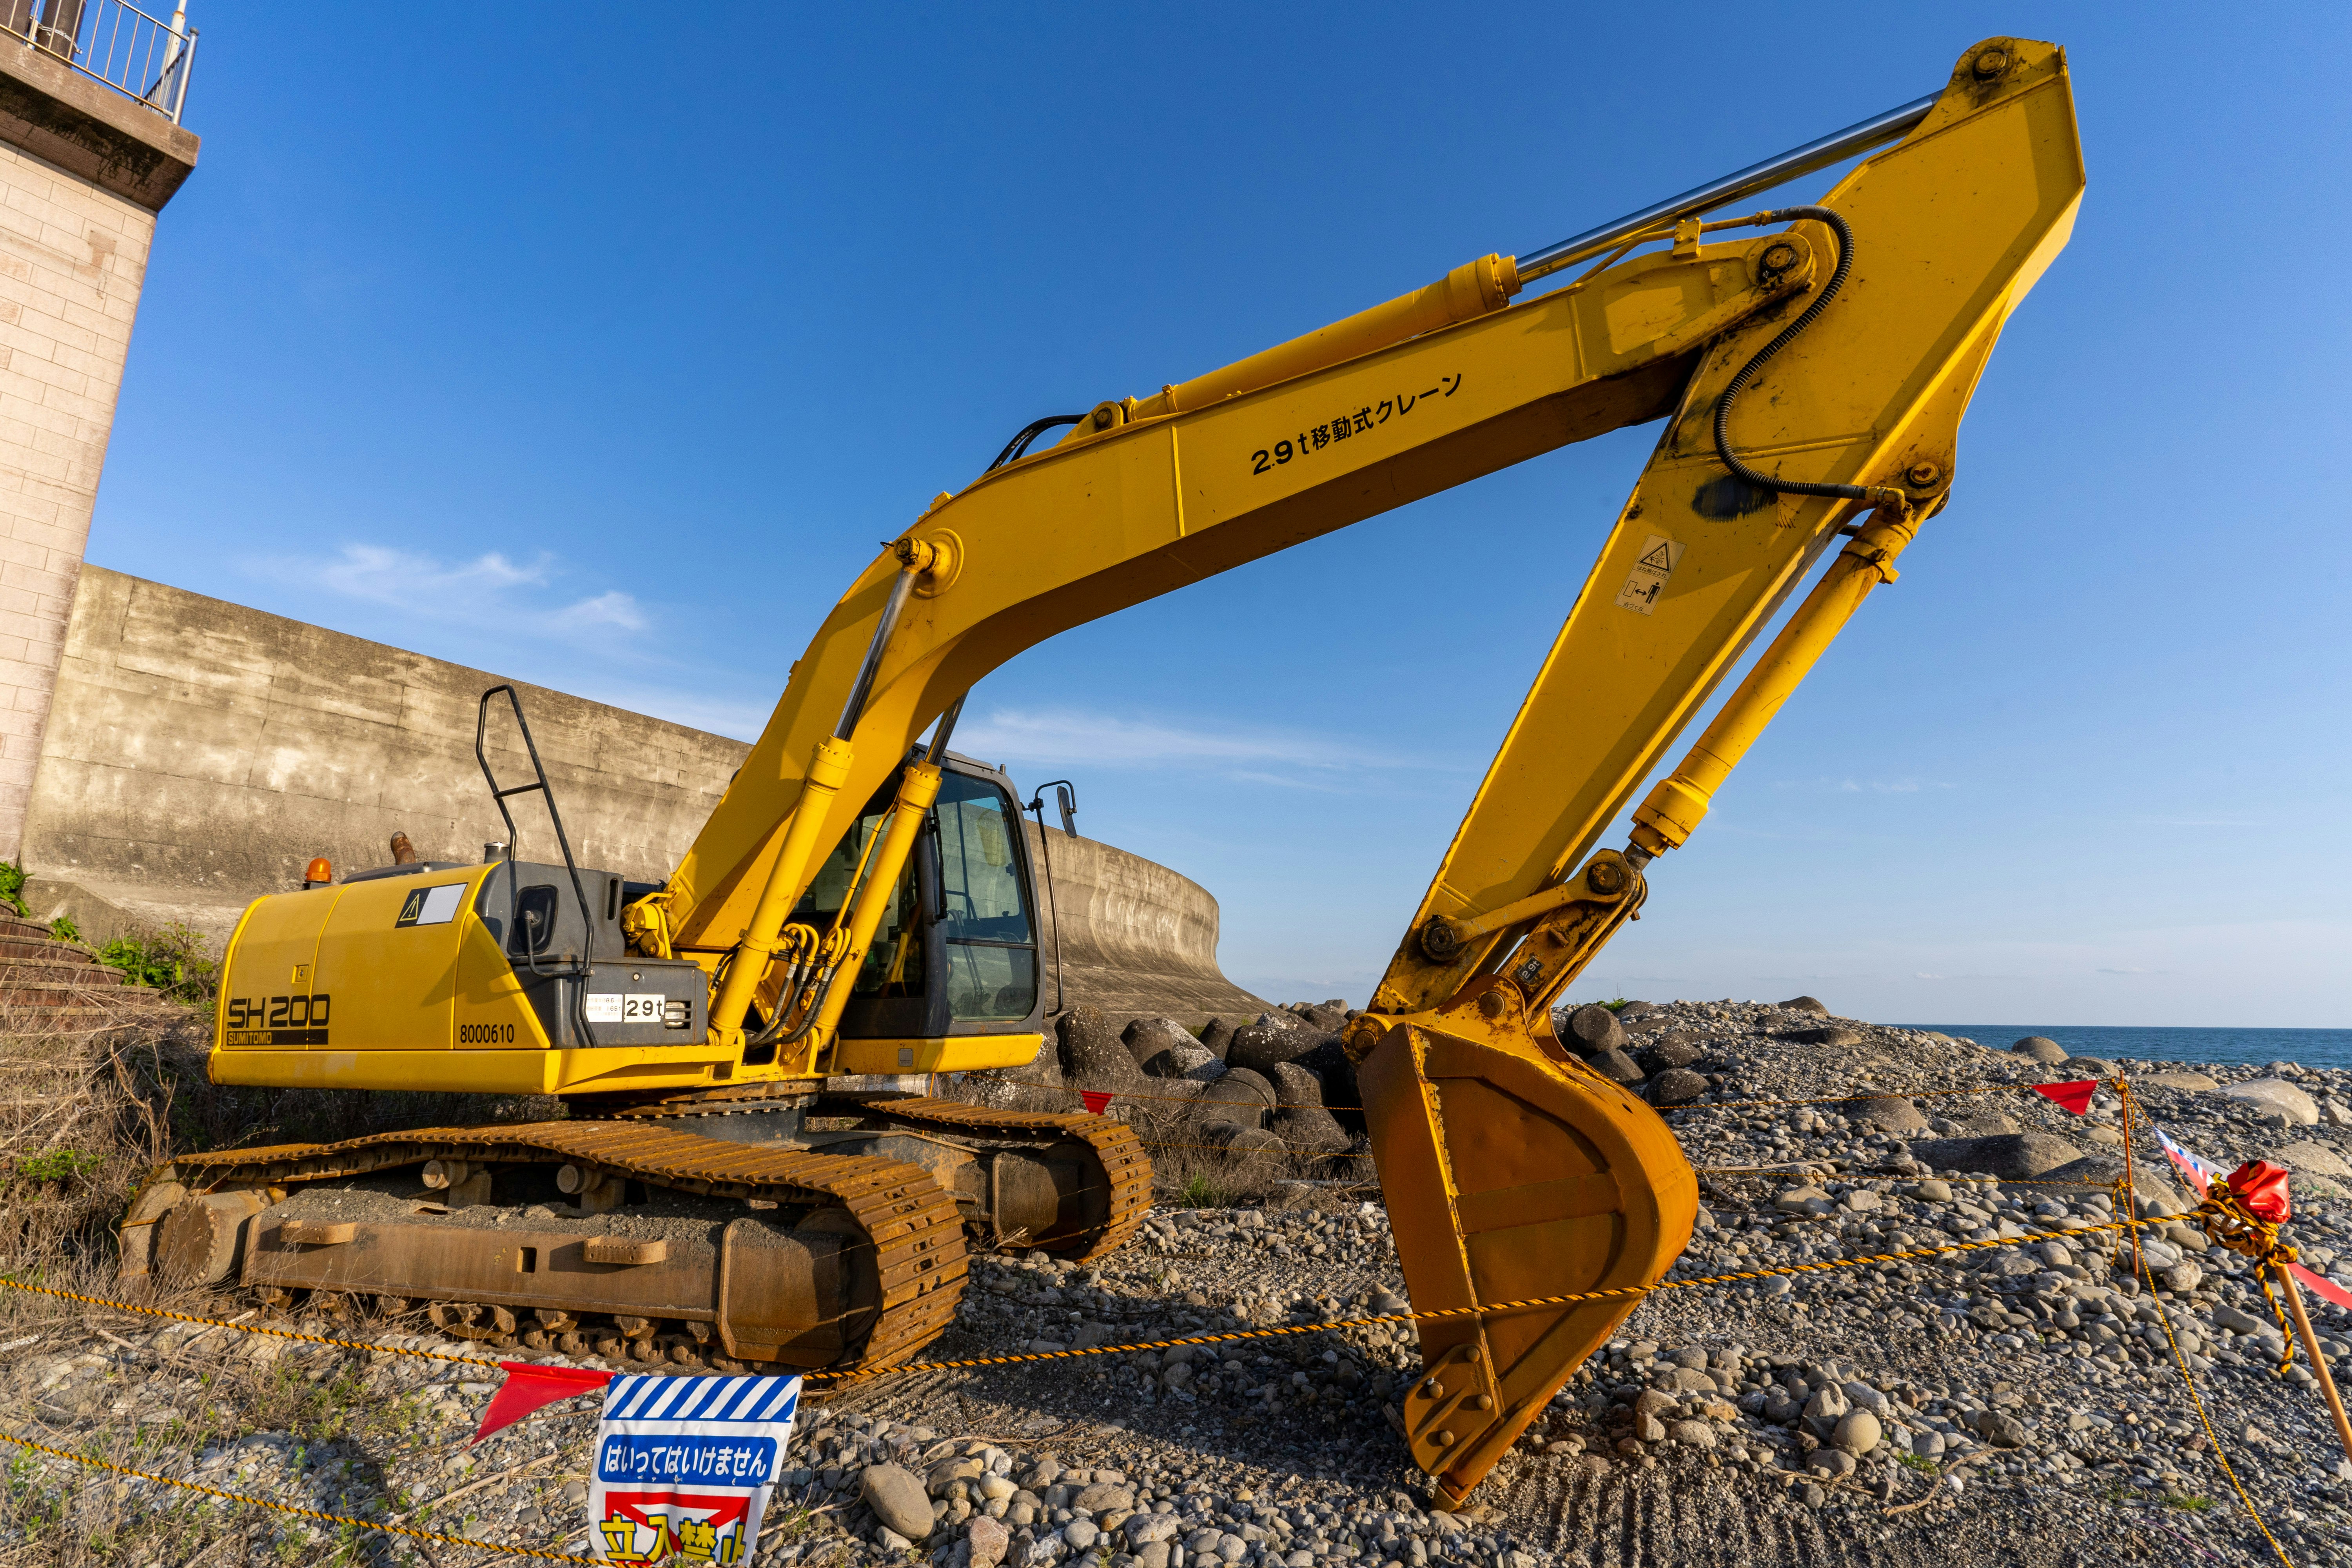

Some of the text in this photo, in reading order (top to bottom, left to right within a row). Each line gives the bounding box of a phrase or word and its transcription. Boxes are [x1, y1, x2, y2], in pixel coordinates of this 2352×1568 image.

[1251, 373, 1461, 476] 2.9t移動式クレーン
[1637, 566, 1666, 578] はね飛ばされ
[1623, 602, 1644, 612] 近づくな
[1522, 960, 1540, 979] 2.9t
[626, 1000, 662, 1016] 2.9t
[228, 1031, 272, 1045] SUMITOMO
[460, 1024, 514, 1043] 8000610
[605, 1445, 766, 1477] はいってはいけません
